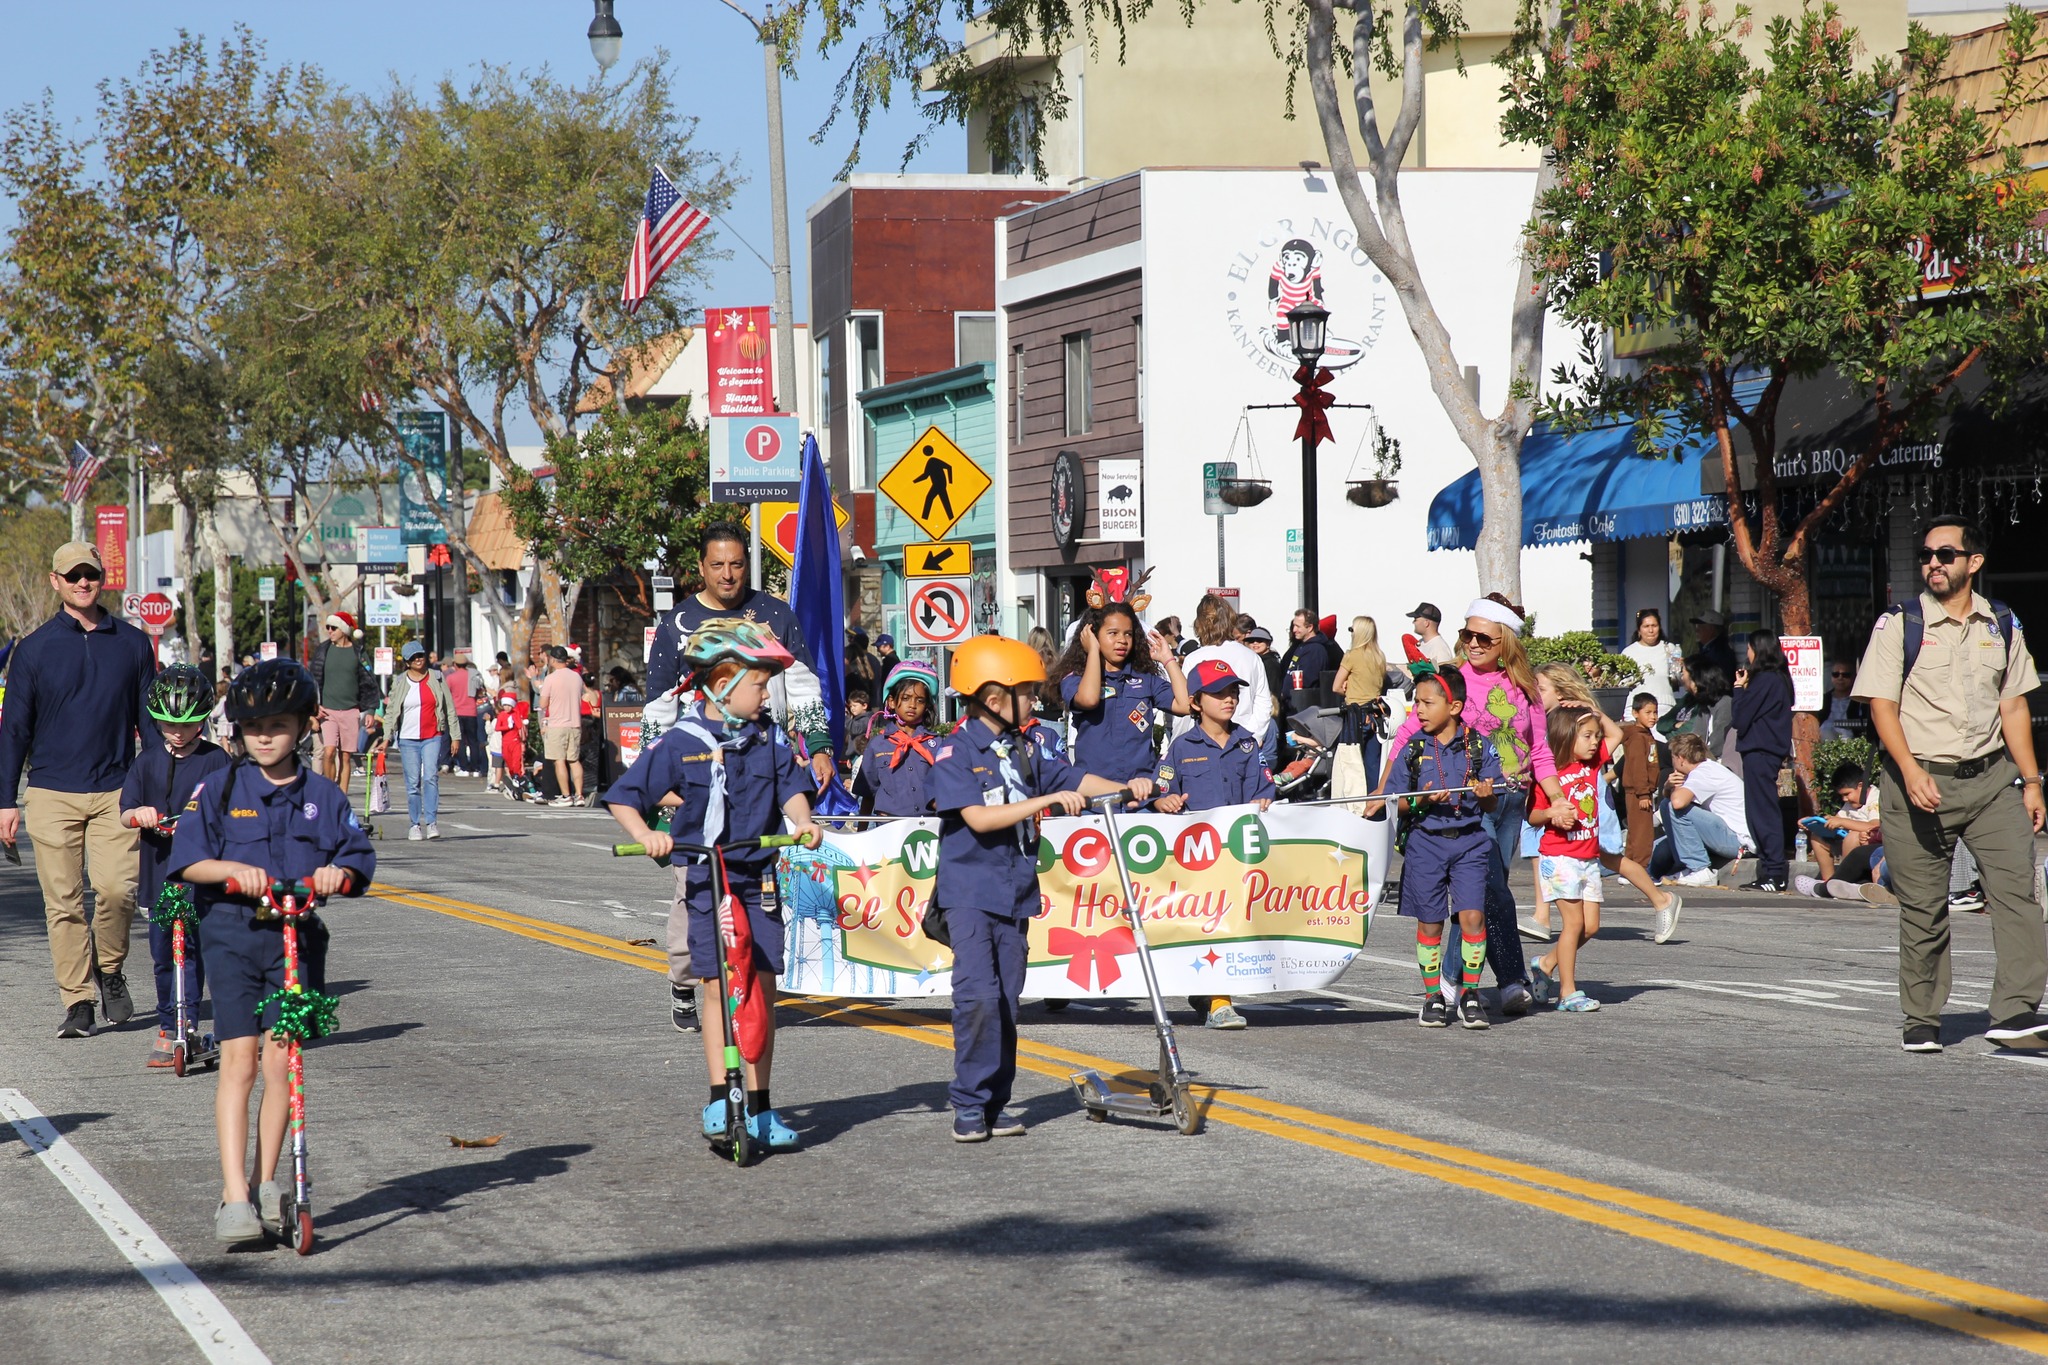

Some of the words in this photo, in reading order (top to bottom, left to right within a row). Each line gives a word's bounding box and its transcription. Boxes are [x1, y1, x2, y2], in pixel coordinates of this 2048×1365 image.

[1227, 252, 1259, 283] EL
[1227, 308, 1293, 382] KANTEEN
[717, 367, 754, 376] Welcome
[755, 366, 764, 375] to
[718, 378, 728, 387] El
[729, 377, 764, 388] Segundo
[725, 392, 759, 404] Happy
[720, 404, 764, 414] Holidays
[757, 431, 772, 456] P
[1878, 442, 1944, 468] Catering
[1811, 448, 1847, 477] BBQ
[733, 466, 760, 477] Public
[762, 466, 796, 478] Parking
[1116, 472, 1138, 481] Serving
[1205, 465, 1215, 477] 2
[725, 488, 737, 496] EL
[738, 487, 789, 499] SEGUNDO
[1102, 508, 1137, 517] BISON
[404, 521, 443, 533] Holidays
[1102, 520, 1138, 530] BURGERS
[1533, 522, 1585, 542] Fantastic
[1588, 513, 1617, 537] Café
[369, 533, 388, 541] Library
[1288, 531, 1296, 542] 2
[1208, 588, 1238, 596] TEMPORARY
[140, 602, 171, 616] STOP
[1780, 640, 1818, 648] TEMPORARY
[1785, 650, 1797, 664] O
[1792, 667, 1817, 676] RKING
[620, 711, 635, 719] Soup
[242, 810, 258, 818] BSA
[904, 824, 1262, 873] WCOME
[1071, 881, 1231, 934] Holiday
[1242, 869, 1373, 921] Parade
[837, 893, 883, 932] El
[1306, 917, 1324, 927] est.
[1327, 915, 1351, 926] 1963
[1226, 953, 1235, 964] El
[1237, 950, 1276, 967] Segundo
[1291, 958, 1345, 970] SEGUNDO
[1226, 965, 1273, 977] Chamber
